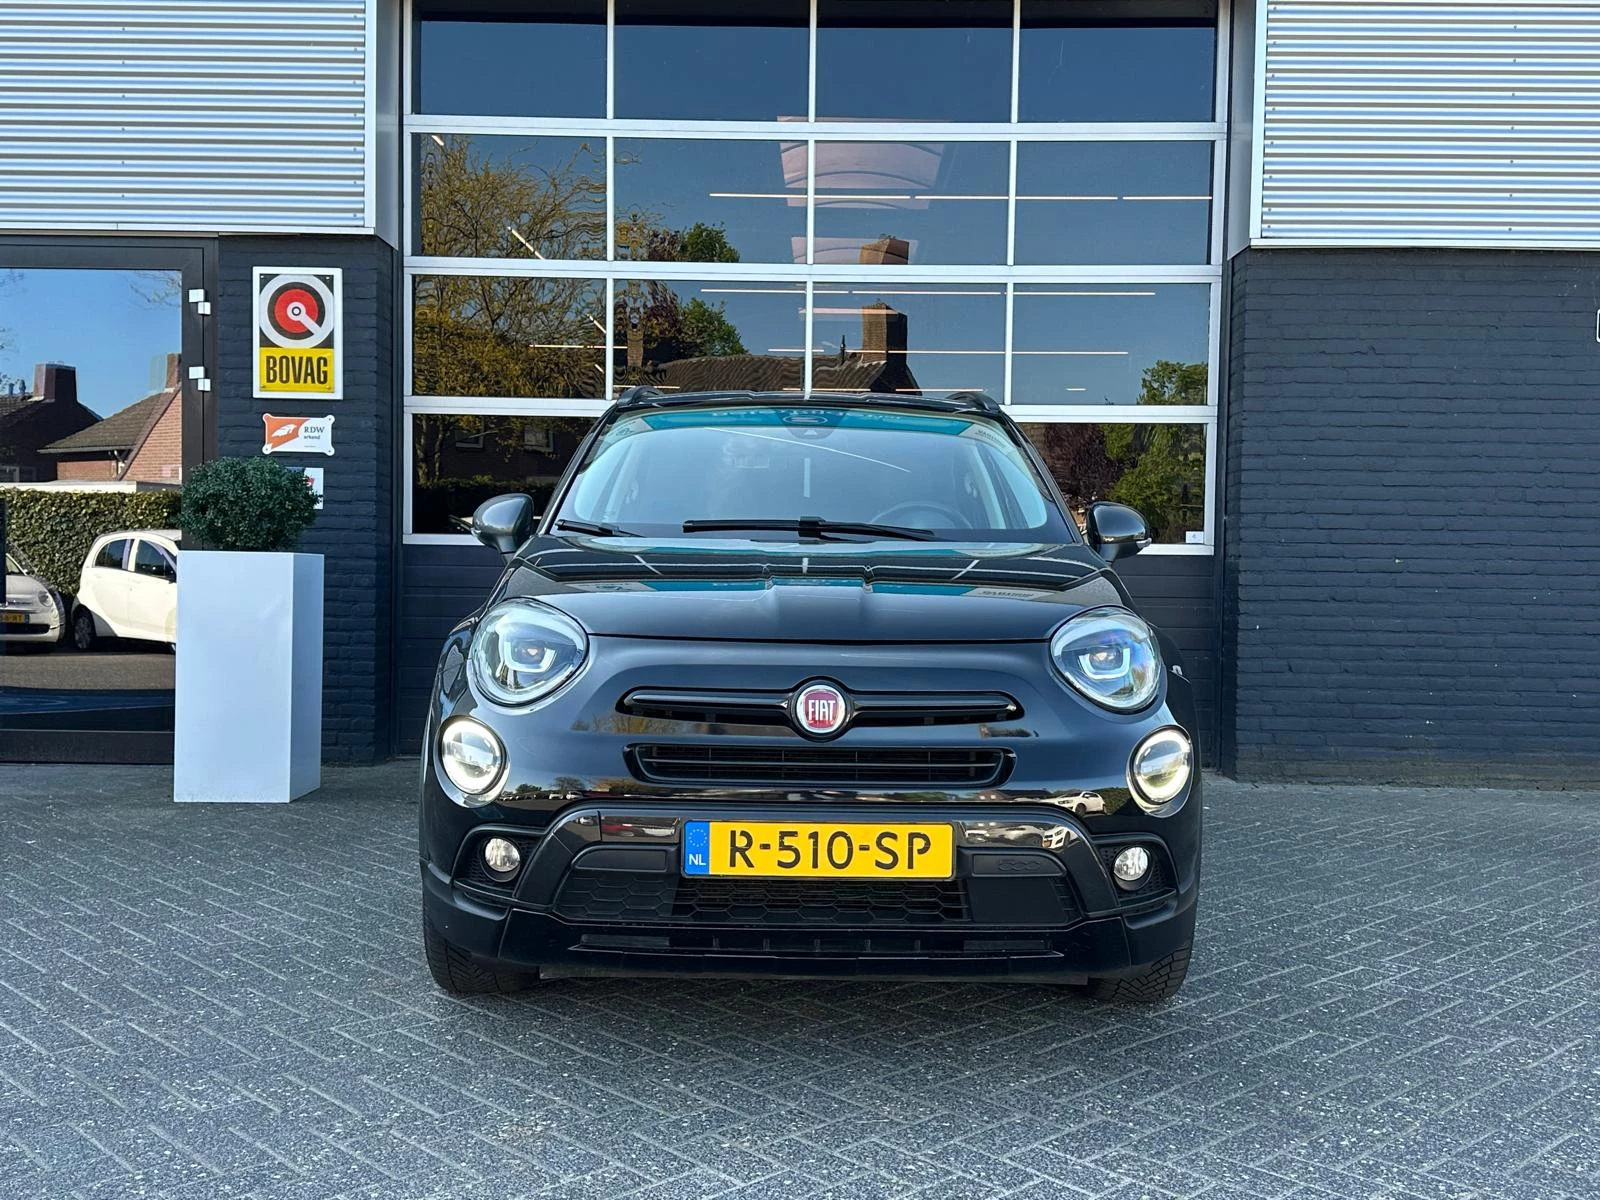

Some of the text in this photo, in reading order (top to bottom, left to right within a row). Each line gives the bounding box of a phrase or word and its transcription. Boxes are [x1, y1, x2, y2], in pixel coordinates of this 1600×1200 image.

[265, 355, 328, 385] BOVAG
[808, 700, 836, 721] FIAT
[688, 830, 931, 870] NL R-510-SP
